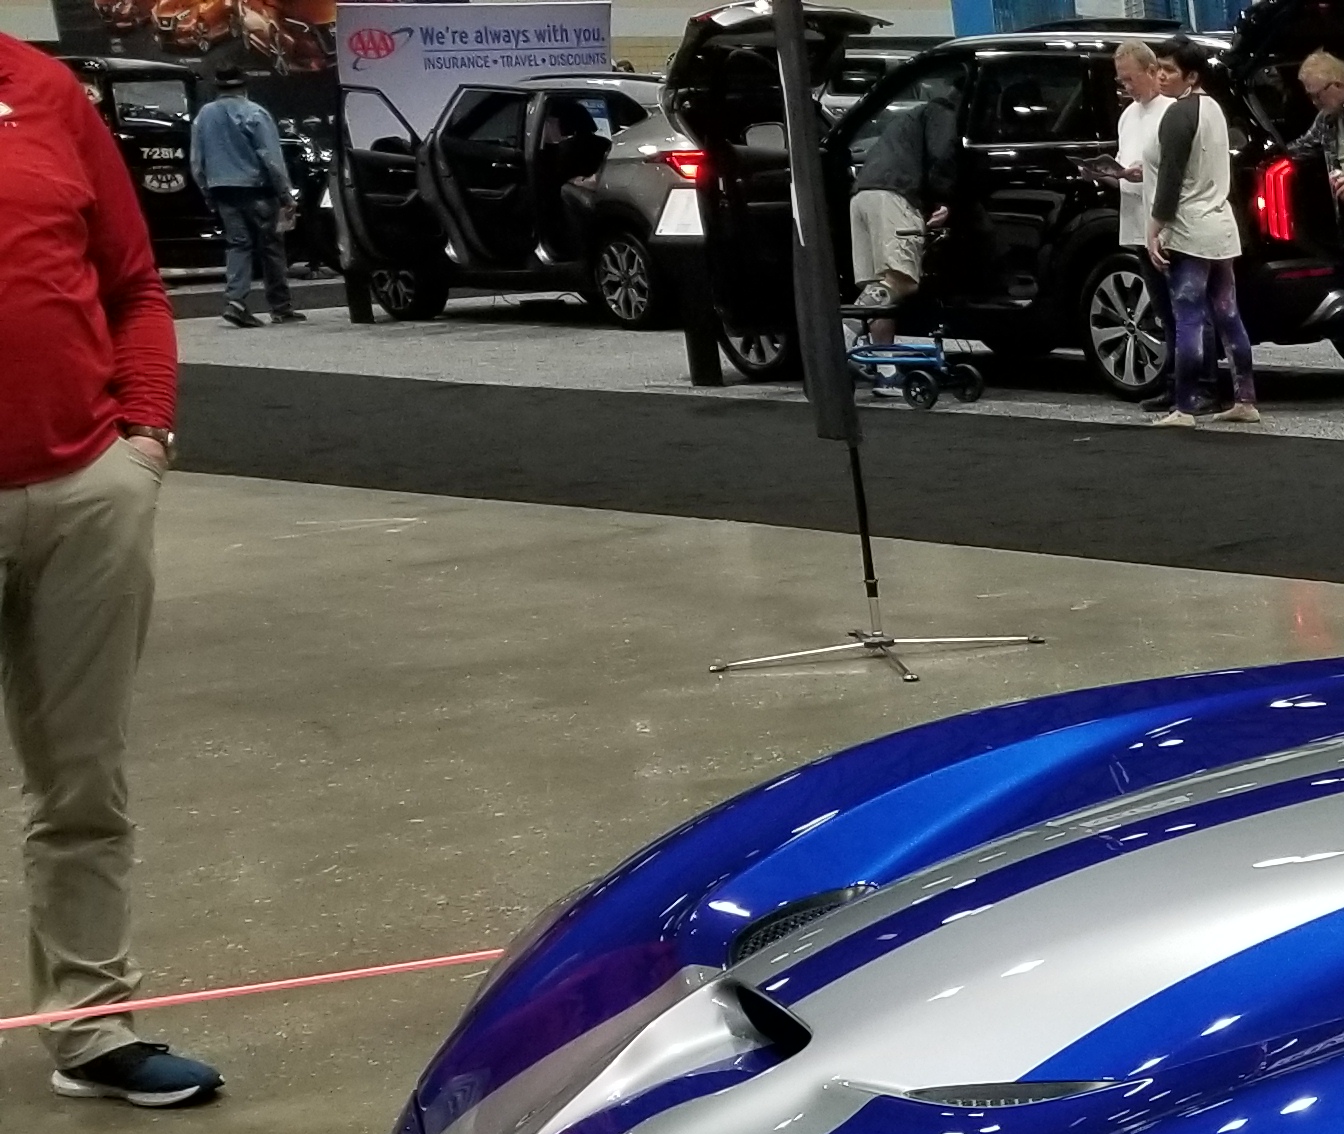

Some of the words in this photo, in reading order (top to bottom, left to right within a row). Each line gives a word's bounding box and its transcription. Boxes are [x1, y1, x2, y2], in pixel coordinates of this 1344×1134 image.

[352, 31, 392, 58] AAA
[420, 26, 469, 46] We're
[475, 25, 530, 48] always
[534, 24, 569, 44] with
[574, 27, 605, 47] you.
[424, 55, 490, 71] INSURANCE
[499, 54, 540, 68] TRAVEL
[549, 52, 607, 67] DISCOUNTS
